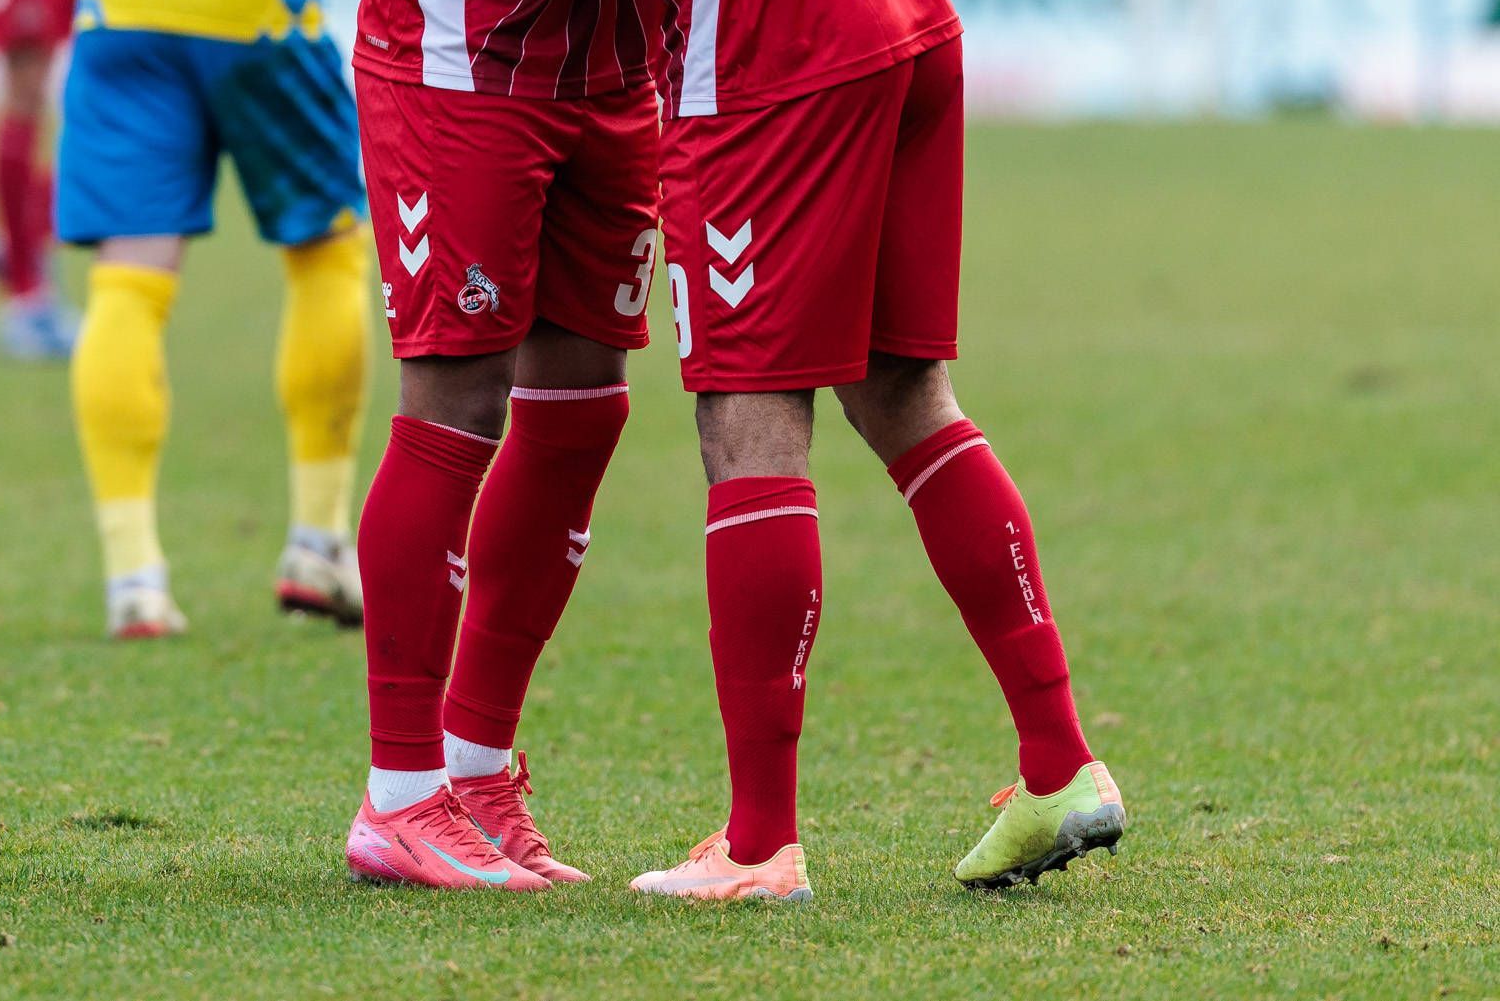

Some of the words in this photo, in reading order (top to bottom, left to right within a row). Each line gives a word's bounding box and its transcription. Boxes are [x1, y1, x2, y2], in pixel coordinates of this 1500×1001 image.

[1005, 520, 1020, 535] 1.
[1009, 542, 1026, 570] FC
[809, 588, 820, 603] 1.
[1017, 573, 1044, 625] KÖLN
[802, 610, 816, 636] FC
[792, 639, 809, 690] KÖLN
